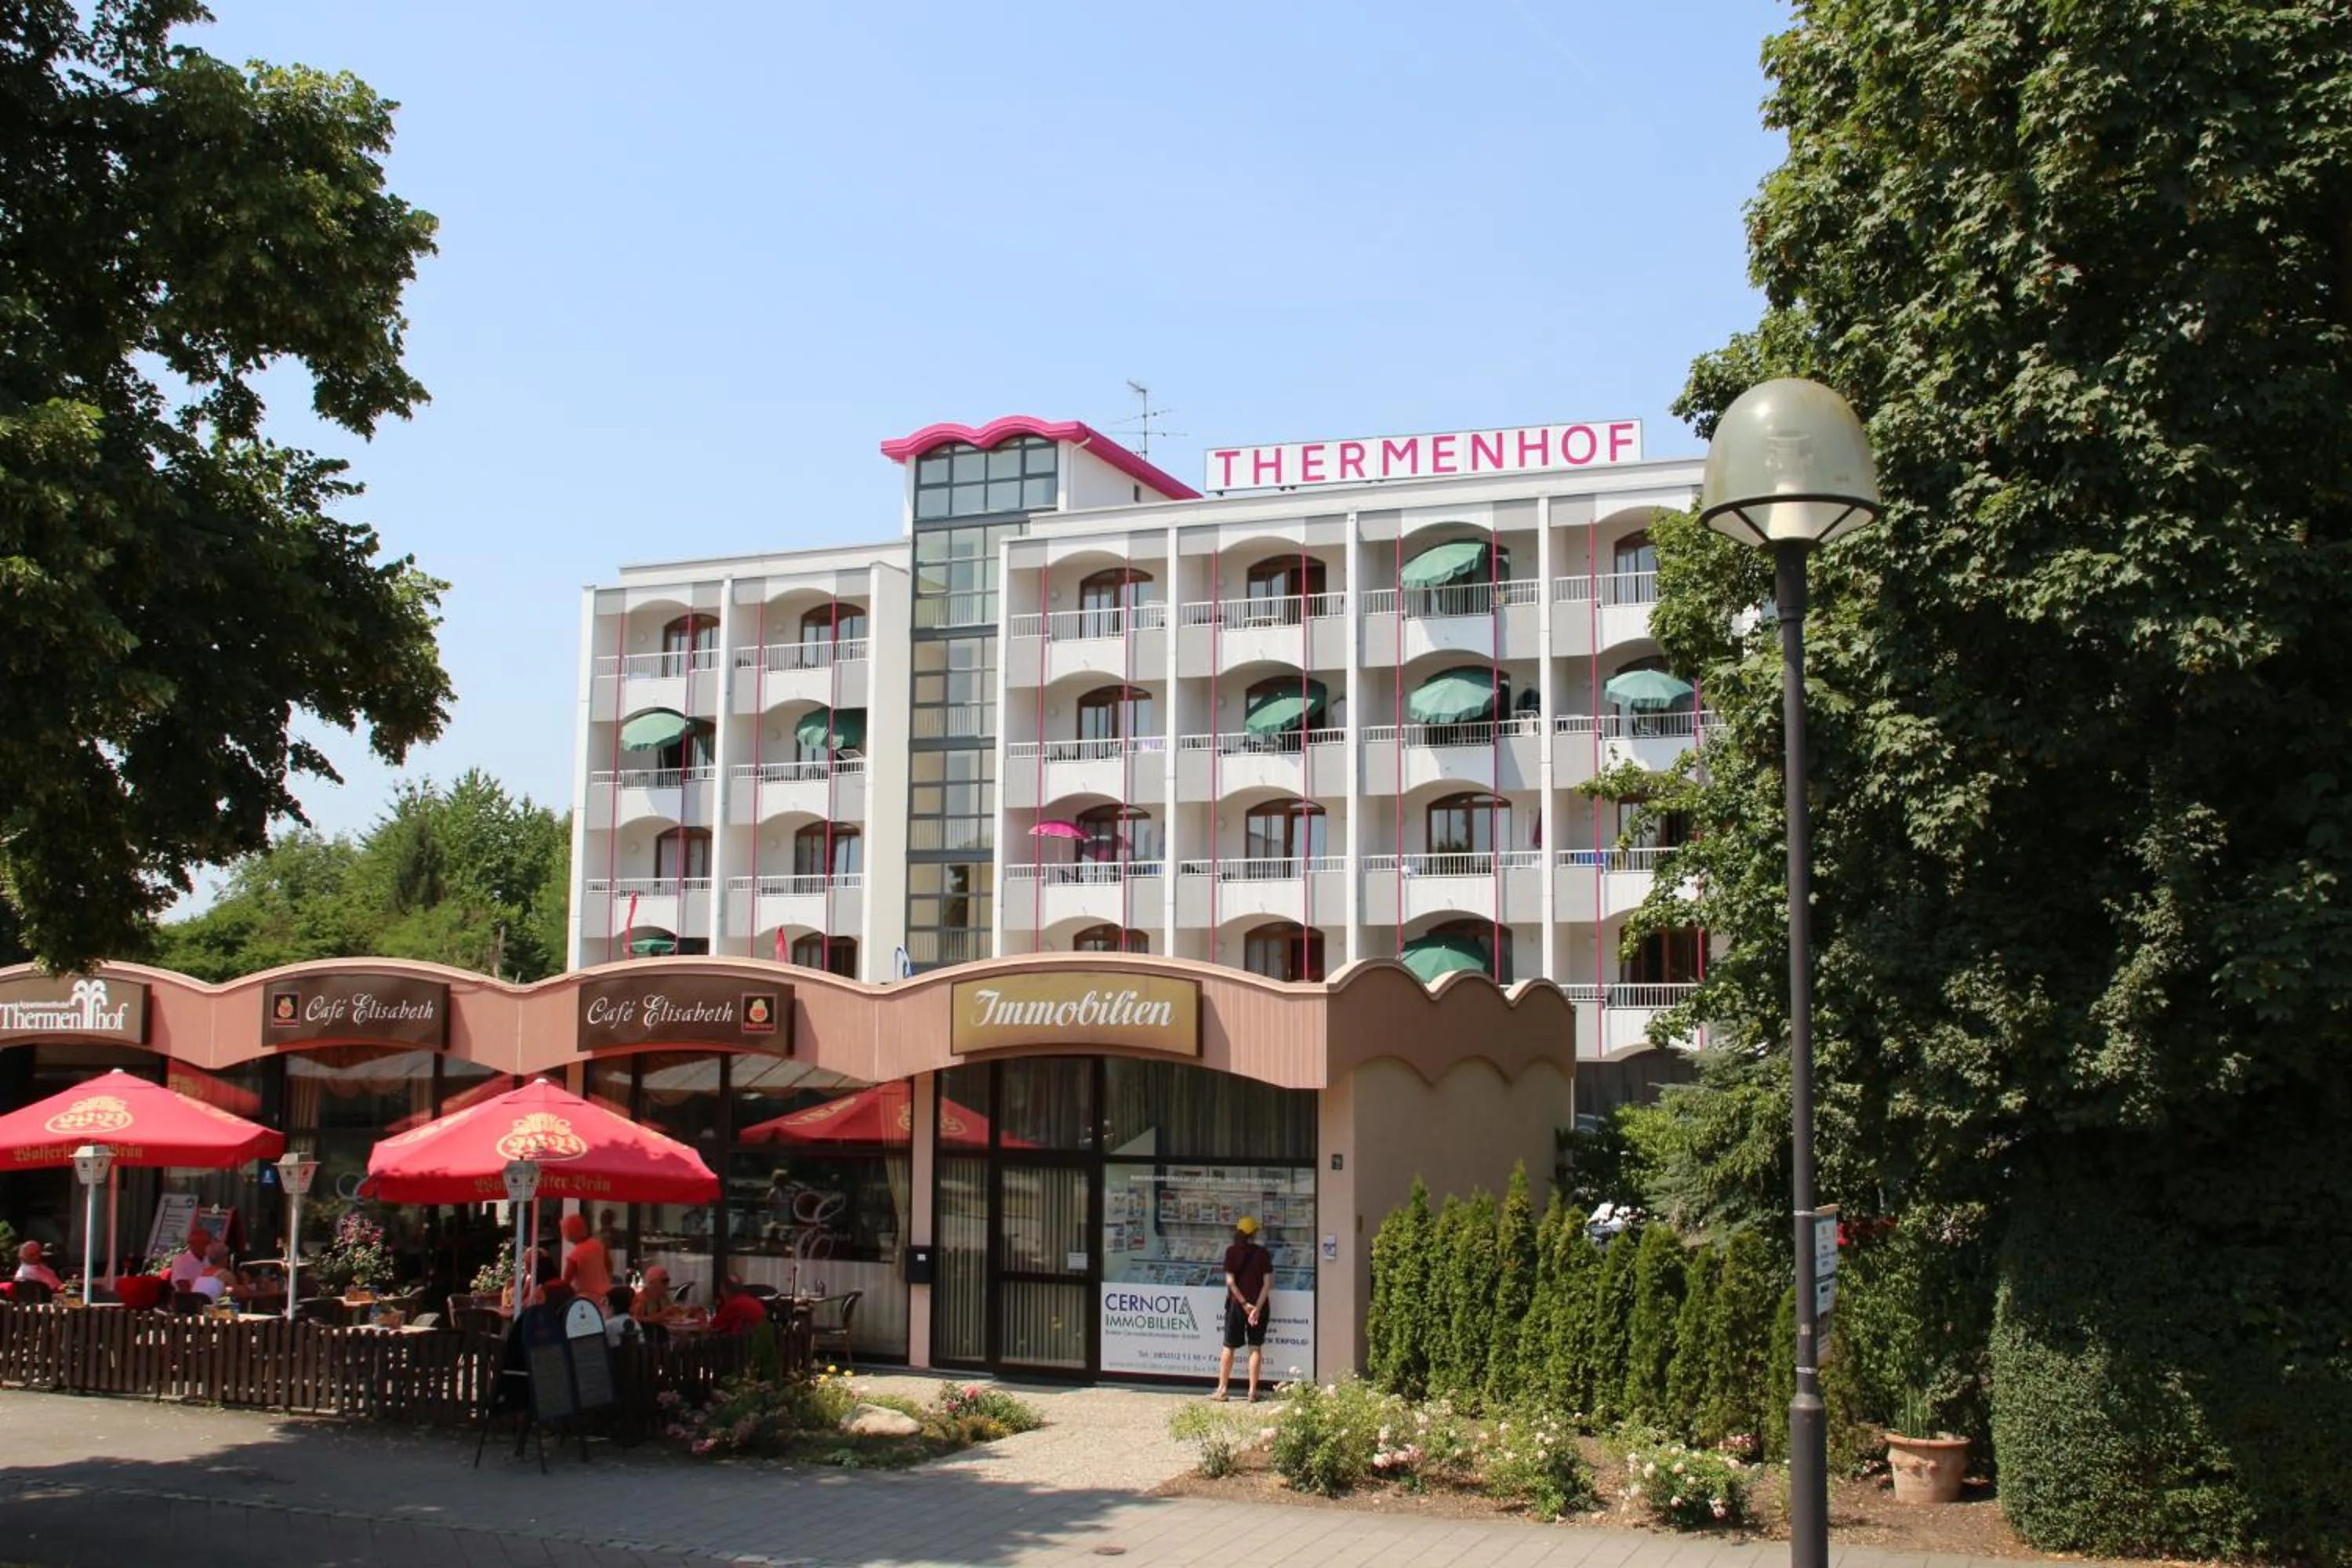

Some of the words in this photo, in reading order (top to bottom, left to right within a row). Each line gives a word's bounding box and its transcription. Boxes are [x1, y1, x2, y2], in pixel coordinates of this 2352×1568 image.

[1214, 423, 1635, 487] THERMENHOF
[305, 995, 347, 1026] Café
[353, 993, 434, 1025] Elisabeth
[587, 996, 637, 1029] Café
[643, 993, 734, 1030] Elisabeth
[971, 989, 1174, 1028] Immobilien
[1104, 1294, 1199, 1331] CERNOTA
[1105, 1314, 1189, 1330] IMMOBILIEN
